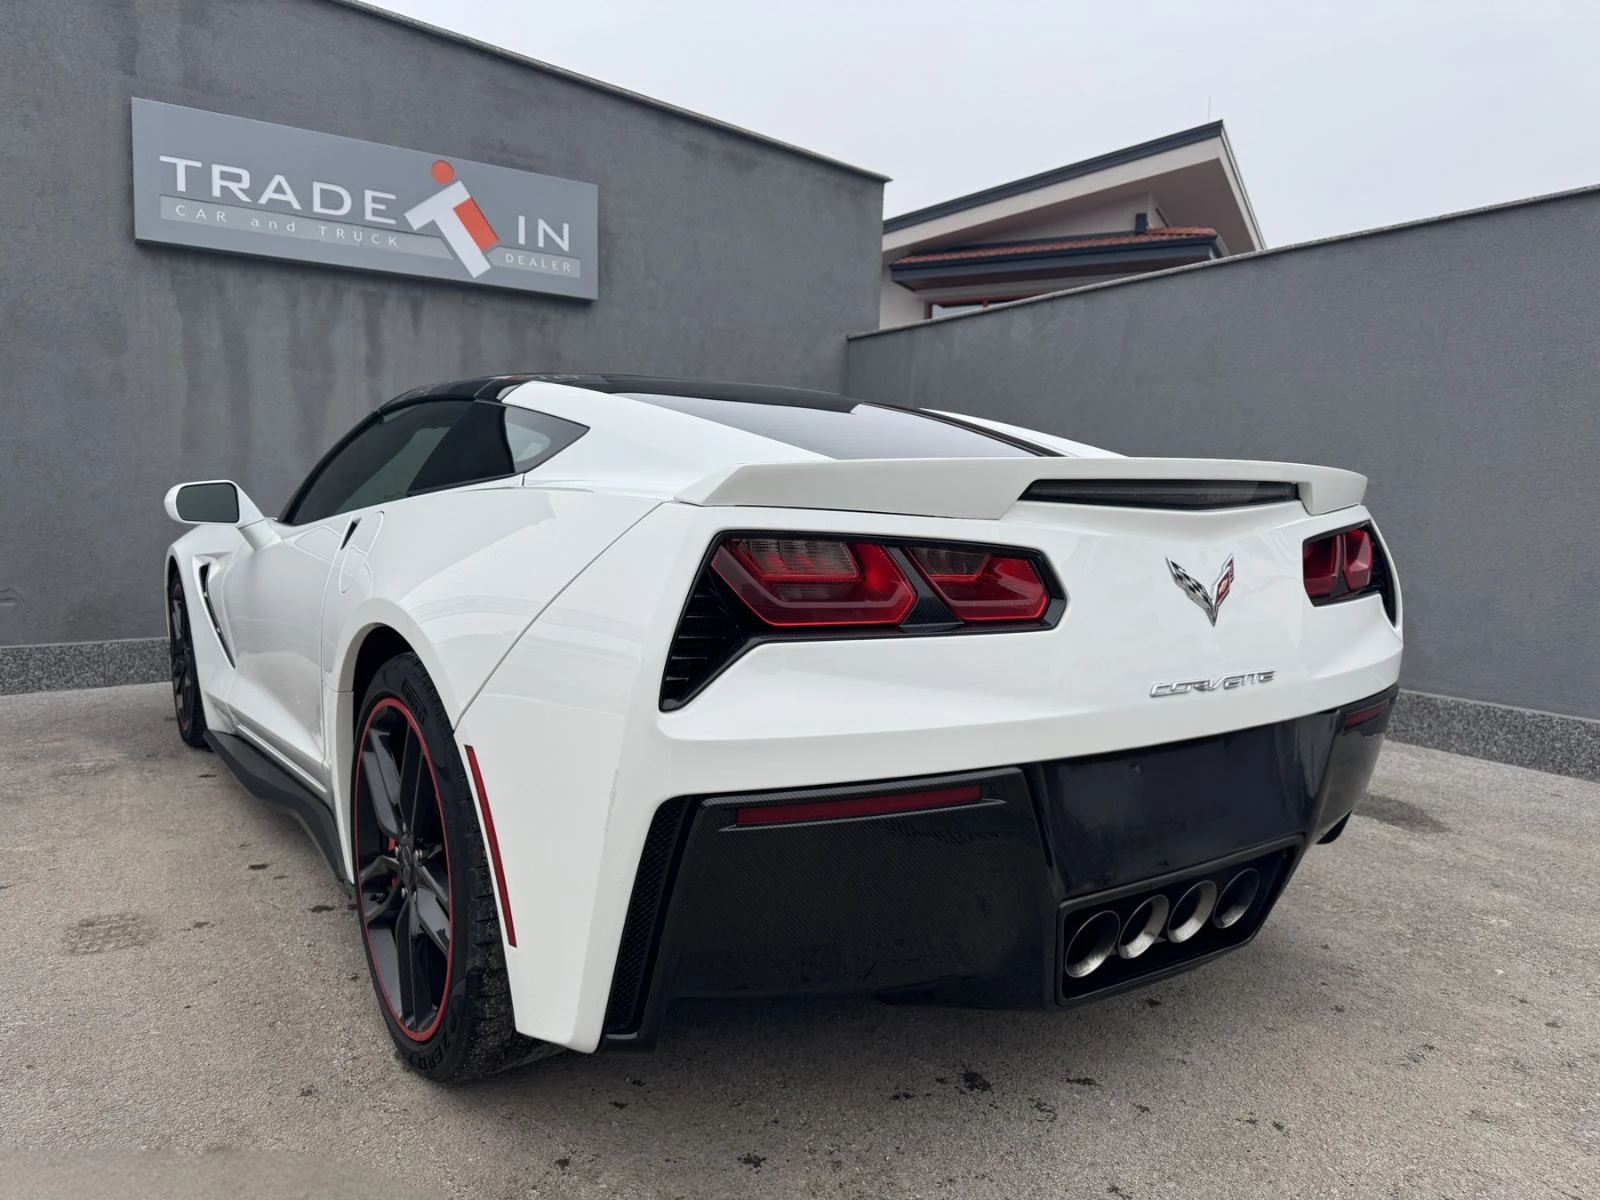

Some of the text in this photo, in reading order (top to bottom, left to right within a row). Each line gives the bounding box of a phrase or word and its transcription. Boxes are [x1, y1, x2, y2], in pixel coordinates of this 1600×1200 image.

[159, 155, 397, 225] TRADE
[518, 215, 569, 252] IN
[175, 204, 571, 272] CAR and TRUCK DEALER
[1150, 669, 1276, 698] CORVETTE
